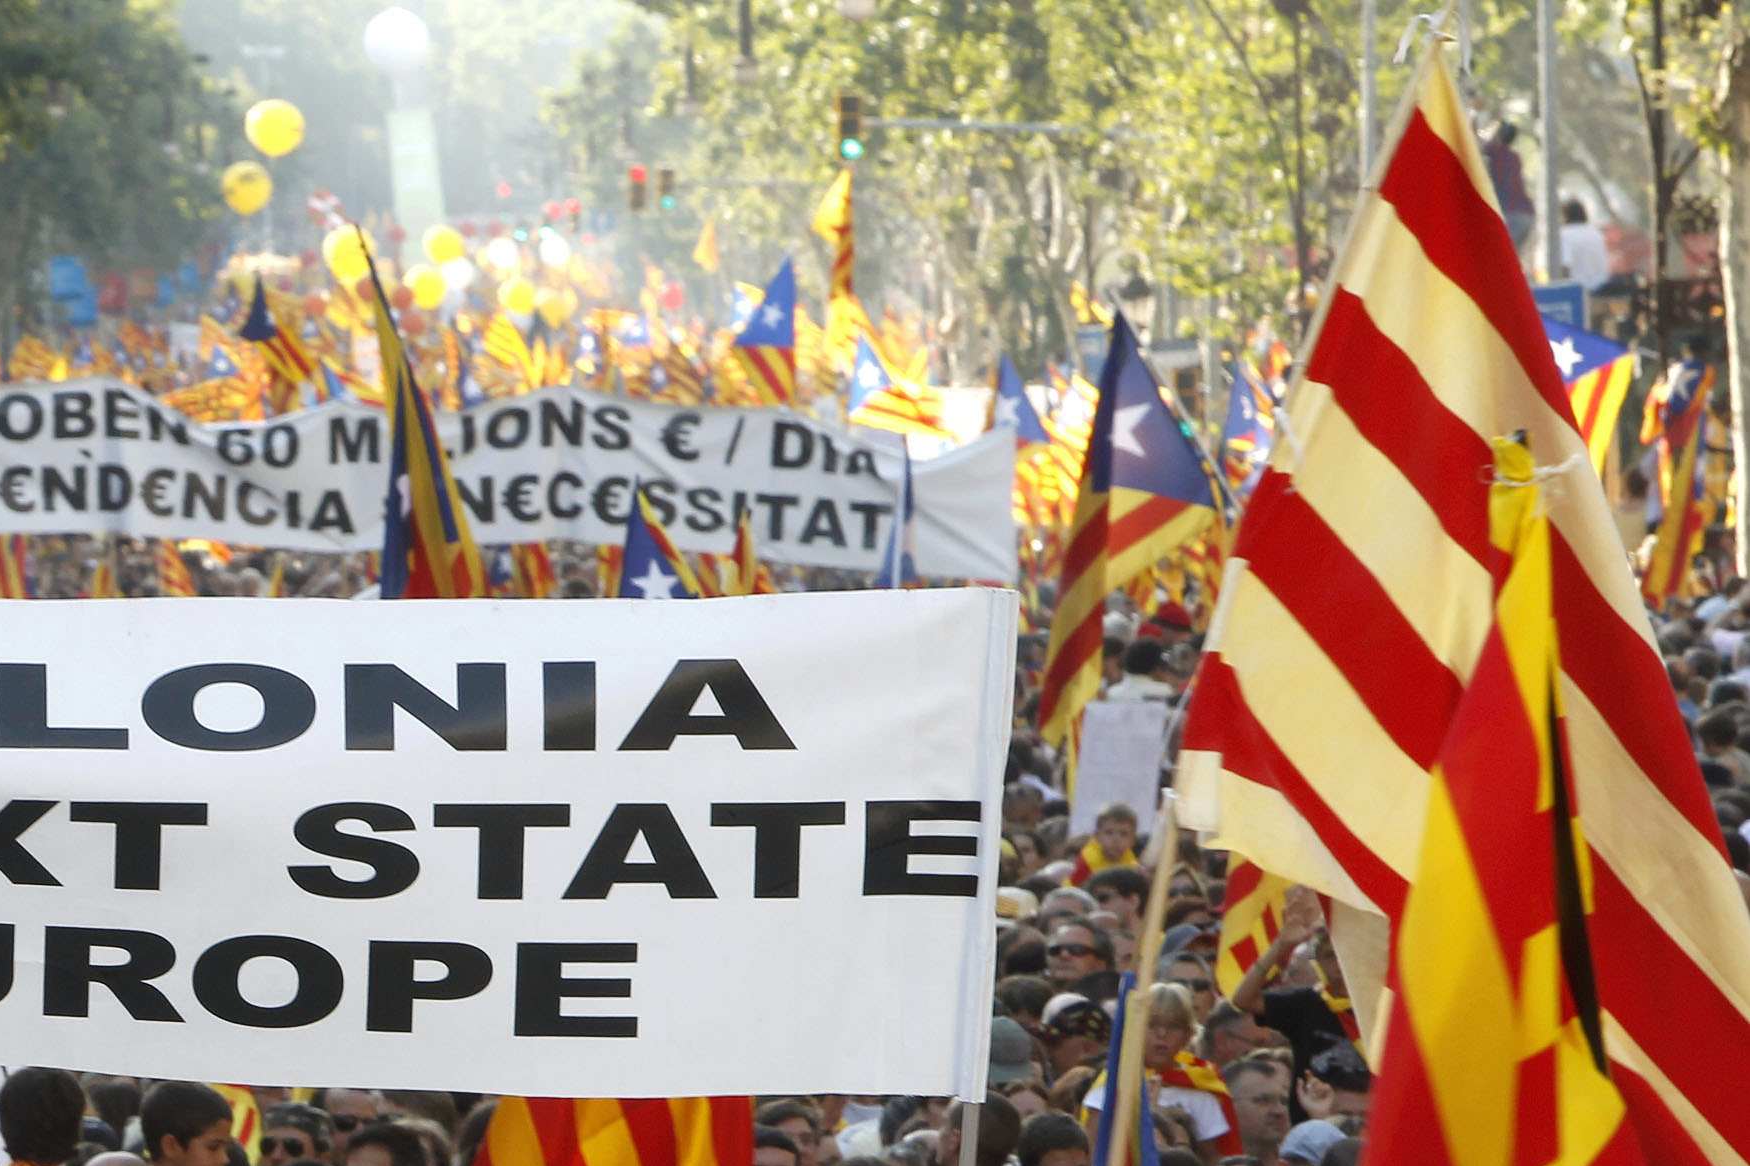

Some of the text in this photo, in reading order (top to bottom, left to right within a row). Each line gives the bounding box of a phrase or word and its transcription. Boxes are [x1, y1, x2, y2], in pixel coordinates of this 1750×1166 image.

[217, 422, 300, 468] 60
[329, 398, 631, 464] MIONS
[660, 412, 701, 462] €
[286, 800, 982, 900] STATE
